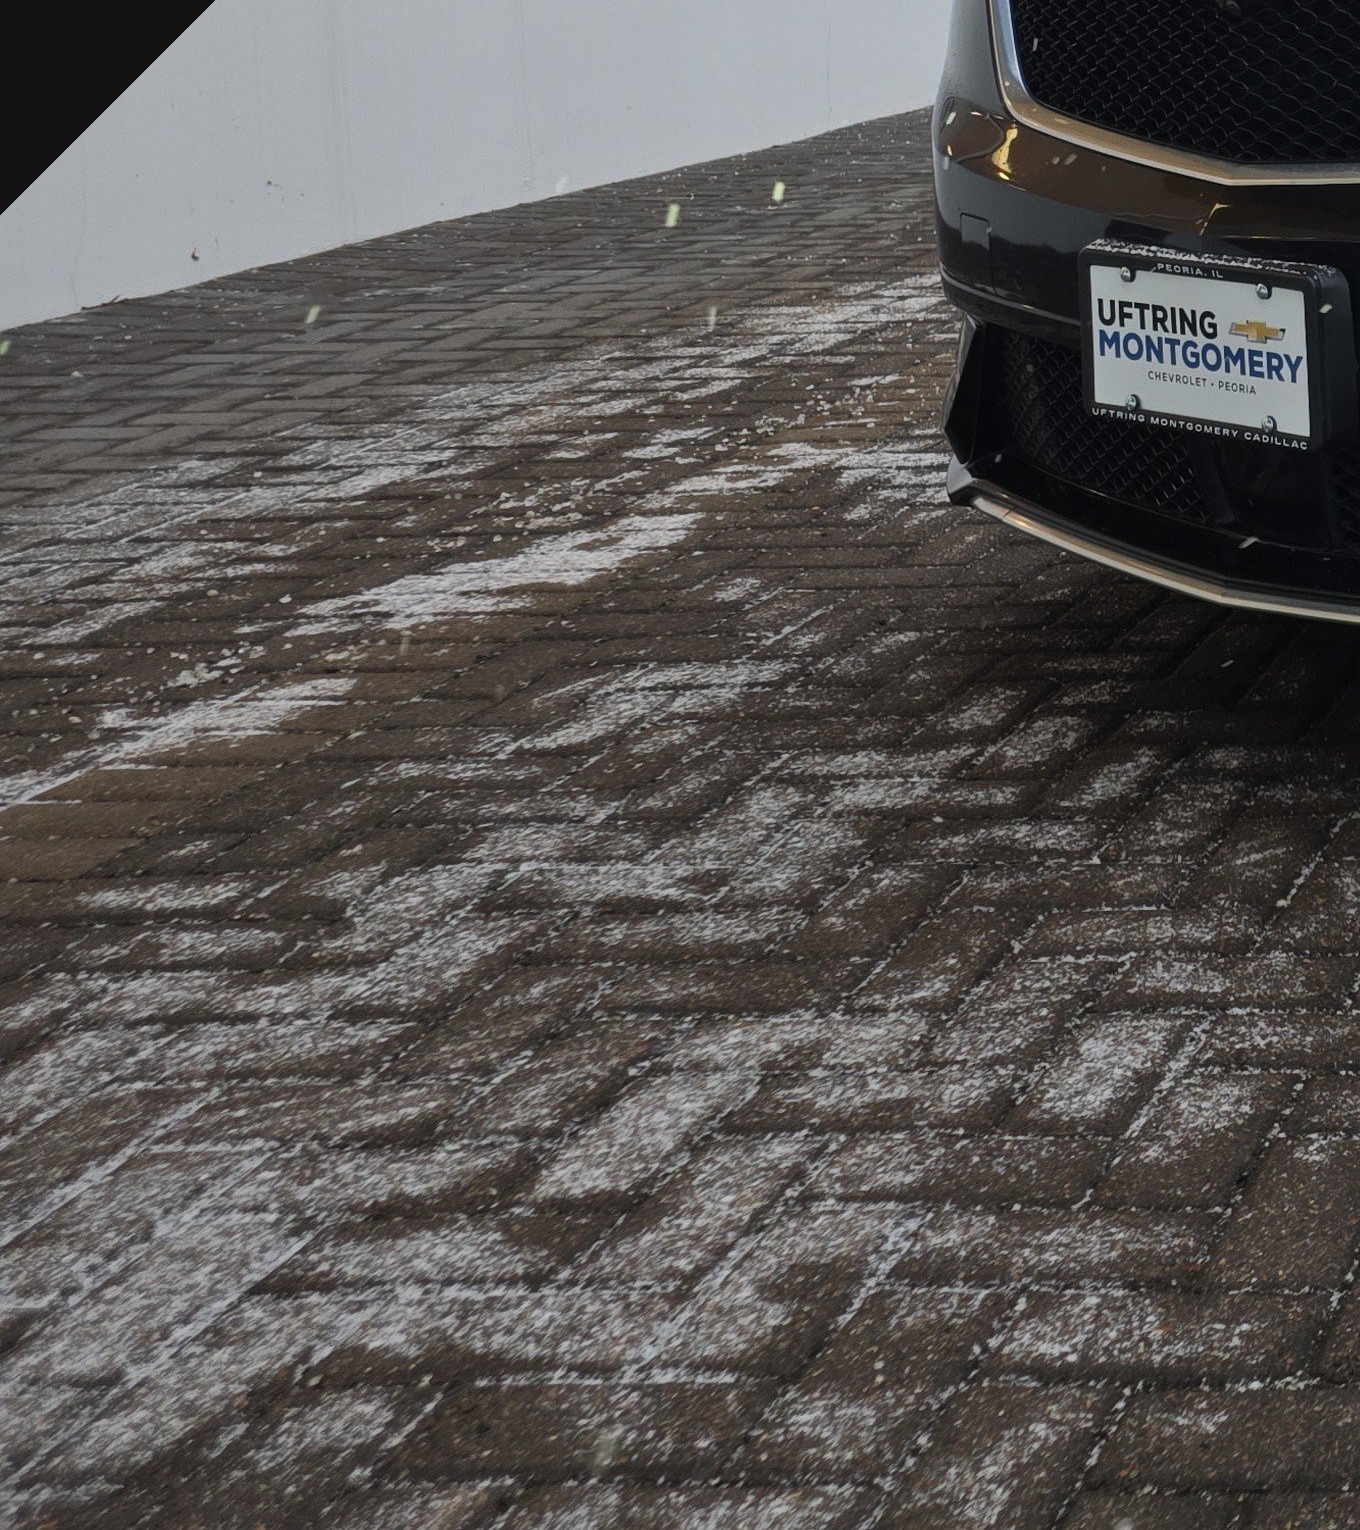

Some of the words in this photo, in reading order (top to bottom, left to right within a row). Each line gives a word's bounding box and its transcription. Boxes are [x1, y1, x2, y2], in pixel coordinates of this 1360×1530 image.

[1211, 270, 1224, 278] IL
[1097, 298, 1218, 340] UFTRING
[1098, 329, 1303, 383] MONTGOMERY
[1147, 370, 1207, 388] CHEVROLET
[1218, 380, 1257, 396] PEORIA
[1092, 407, 1146, 422] UFTRING
[1150, 416, 1239, 438] MONTGOMERY
[1243, 431, 1308, 451] CADILLAC
